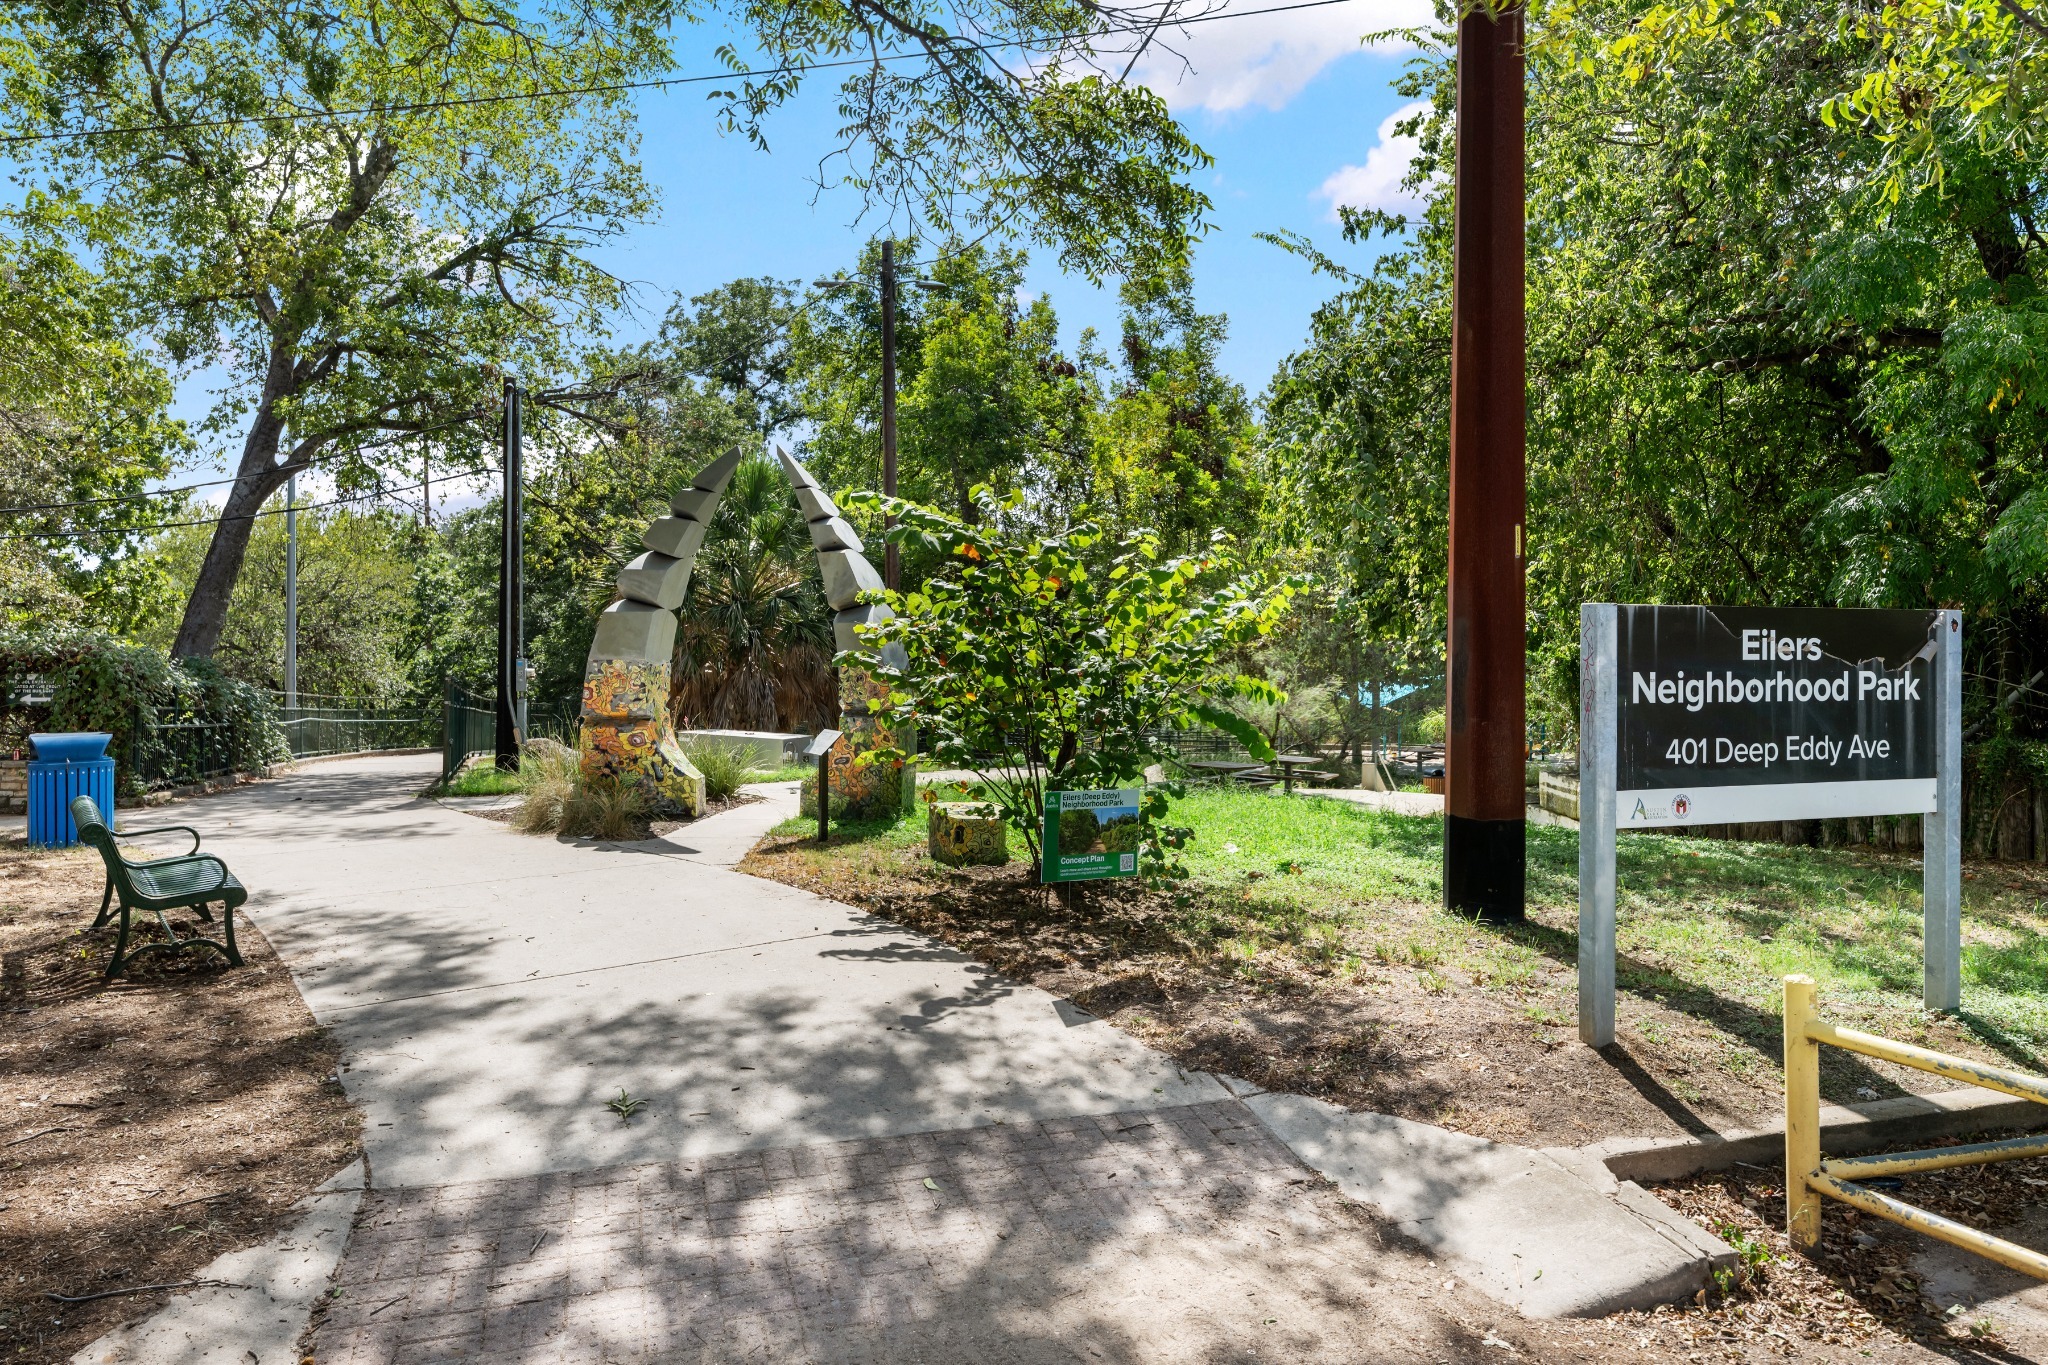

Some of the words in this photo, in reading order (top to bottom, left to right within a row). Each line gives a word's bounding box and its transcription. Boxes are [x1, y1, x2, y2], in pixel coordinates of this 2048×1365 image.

[1742, 628, 1822, 661] Eilers
[1632, 670, 1849, 712] Neighborhood
[1858, 669, 1921, 702] Park
[1665, 737, 1707, 764] 401
[1715, 736, 1779, 768] Deep
[1787, 735, 1843, 767] Eddy
[1848, 734, 1890, 759] Ave
[1062, 793, 1081, 801] Eilers
[1082, 793, 1101, 801] (Deep
[1101, 792, 1120, 800] Eddy)
[1062, 800, 1108, 809] Neighborhood
[1060, 856, 1089, 865] Concept
